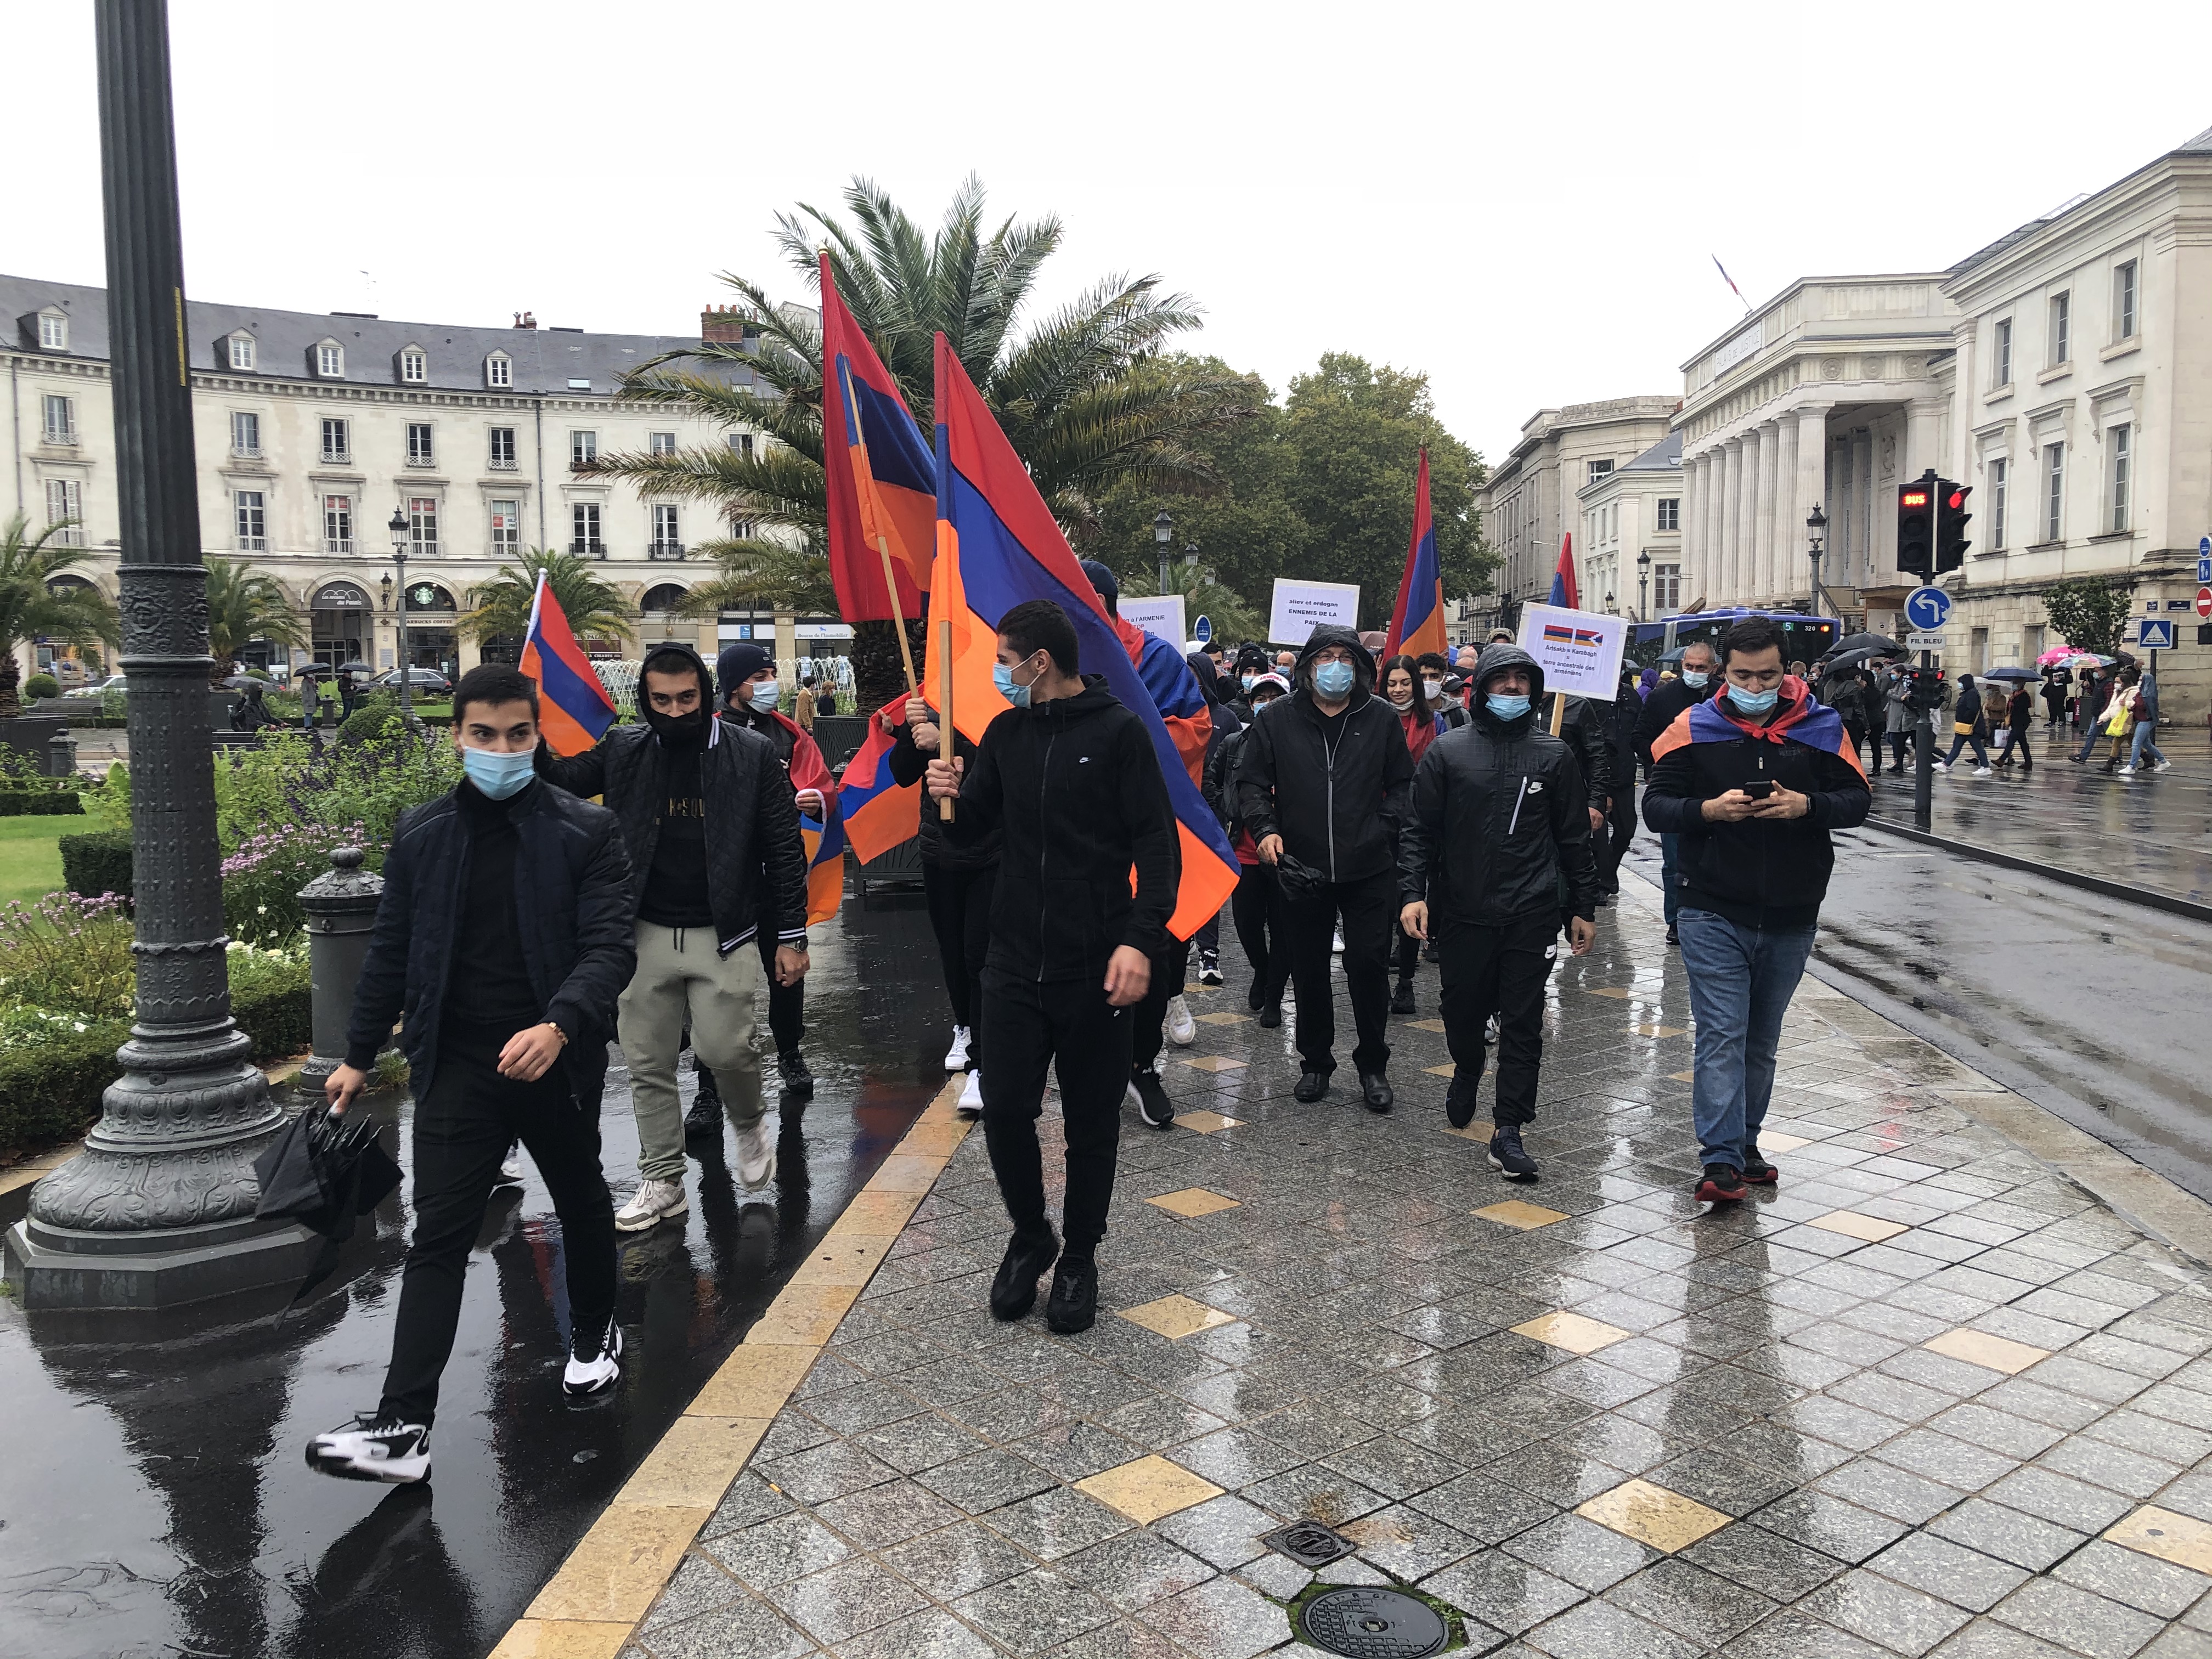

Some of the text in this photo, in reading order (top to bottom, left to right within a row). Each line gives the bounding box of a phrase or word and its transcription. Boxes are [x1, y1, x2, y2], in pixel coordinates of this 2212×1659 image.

[1716, 329, 1760, 366] PALAIS DE JUSTICE
[1905, 494, 1925, 505] BUS
[1785, 622, 1792, 631] 5
[1571, 648, 1597, 658] Karabagh
[1556, 661, 1584, 670] ancestrale
[1554, 668, 1582, 676] arméniens
